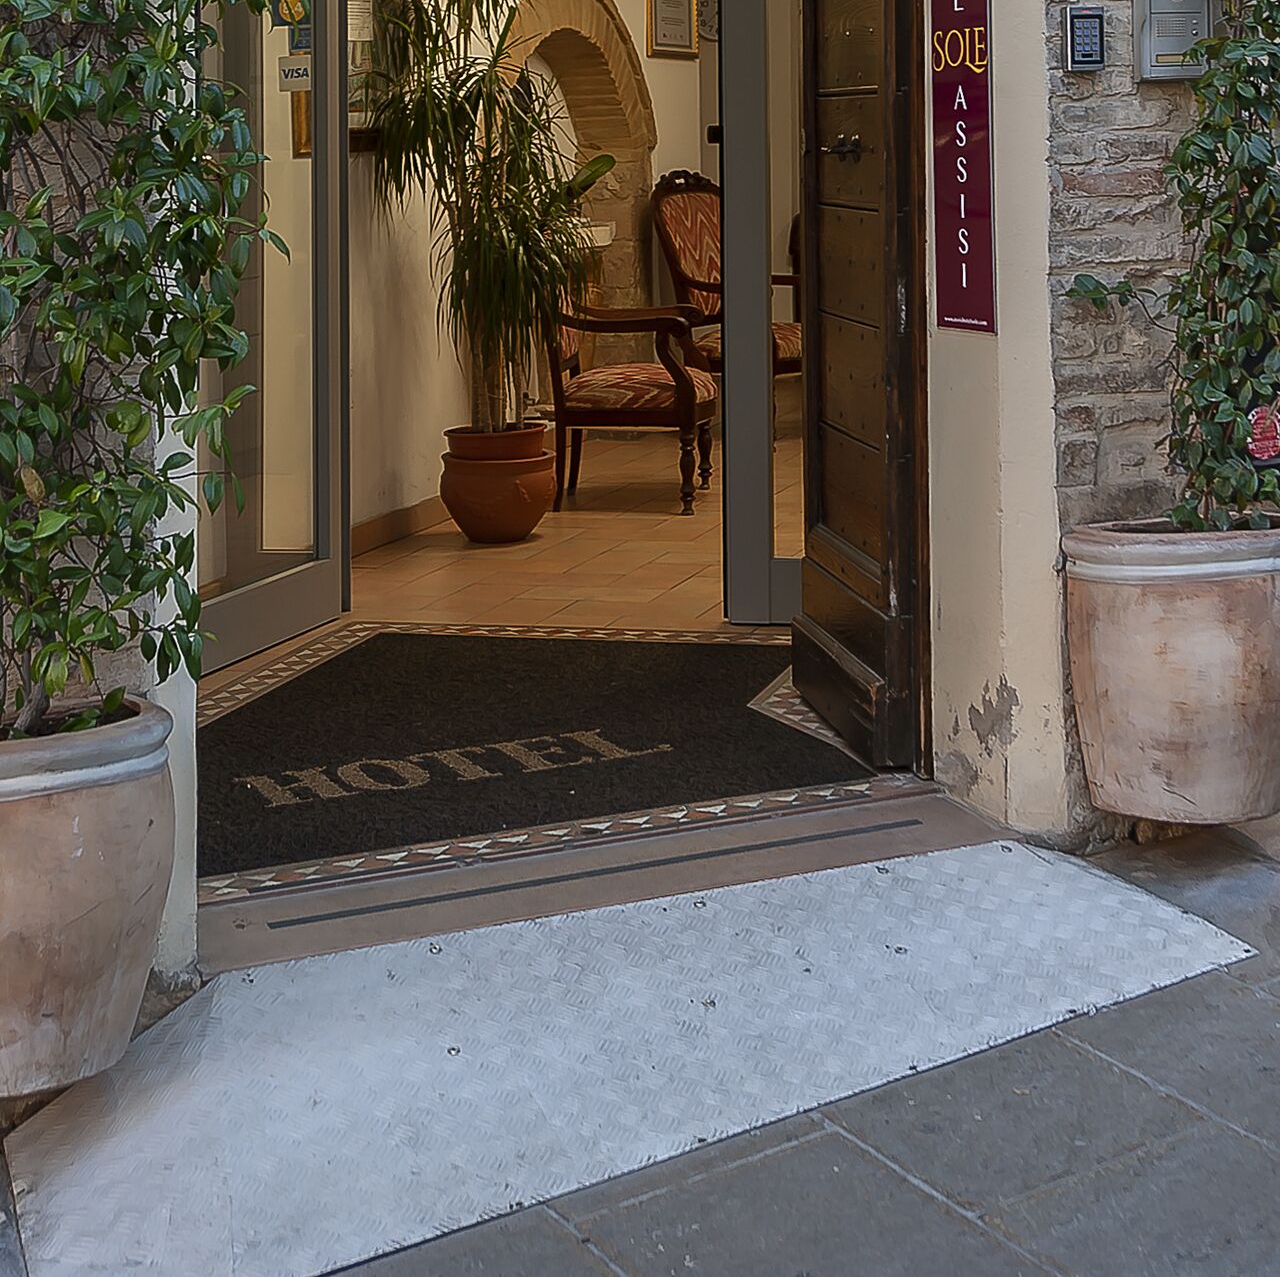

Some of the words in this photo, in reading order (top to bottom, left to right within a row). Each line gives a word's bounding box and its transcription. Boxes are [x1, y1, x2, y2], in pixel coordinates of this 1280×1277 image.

[282, 67, 310, 80] VISA
[933, 26, 988, 74] SOLE
[953, 84, 969, 288] ASSISI
[233, 728, 674, 808] HOTEL
